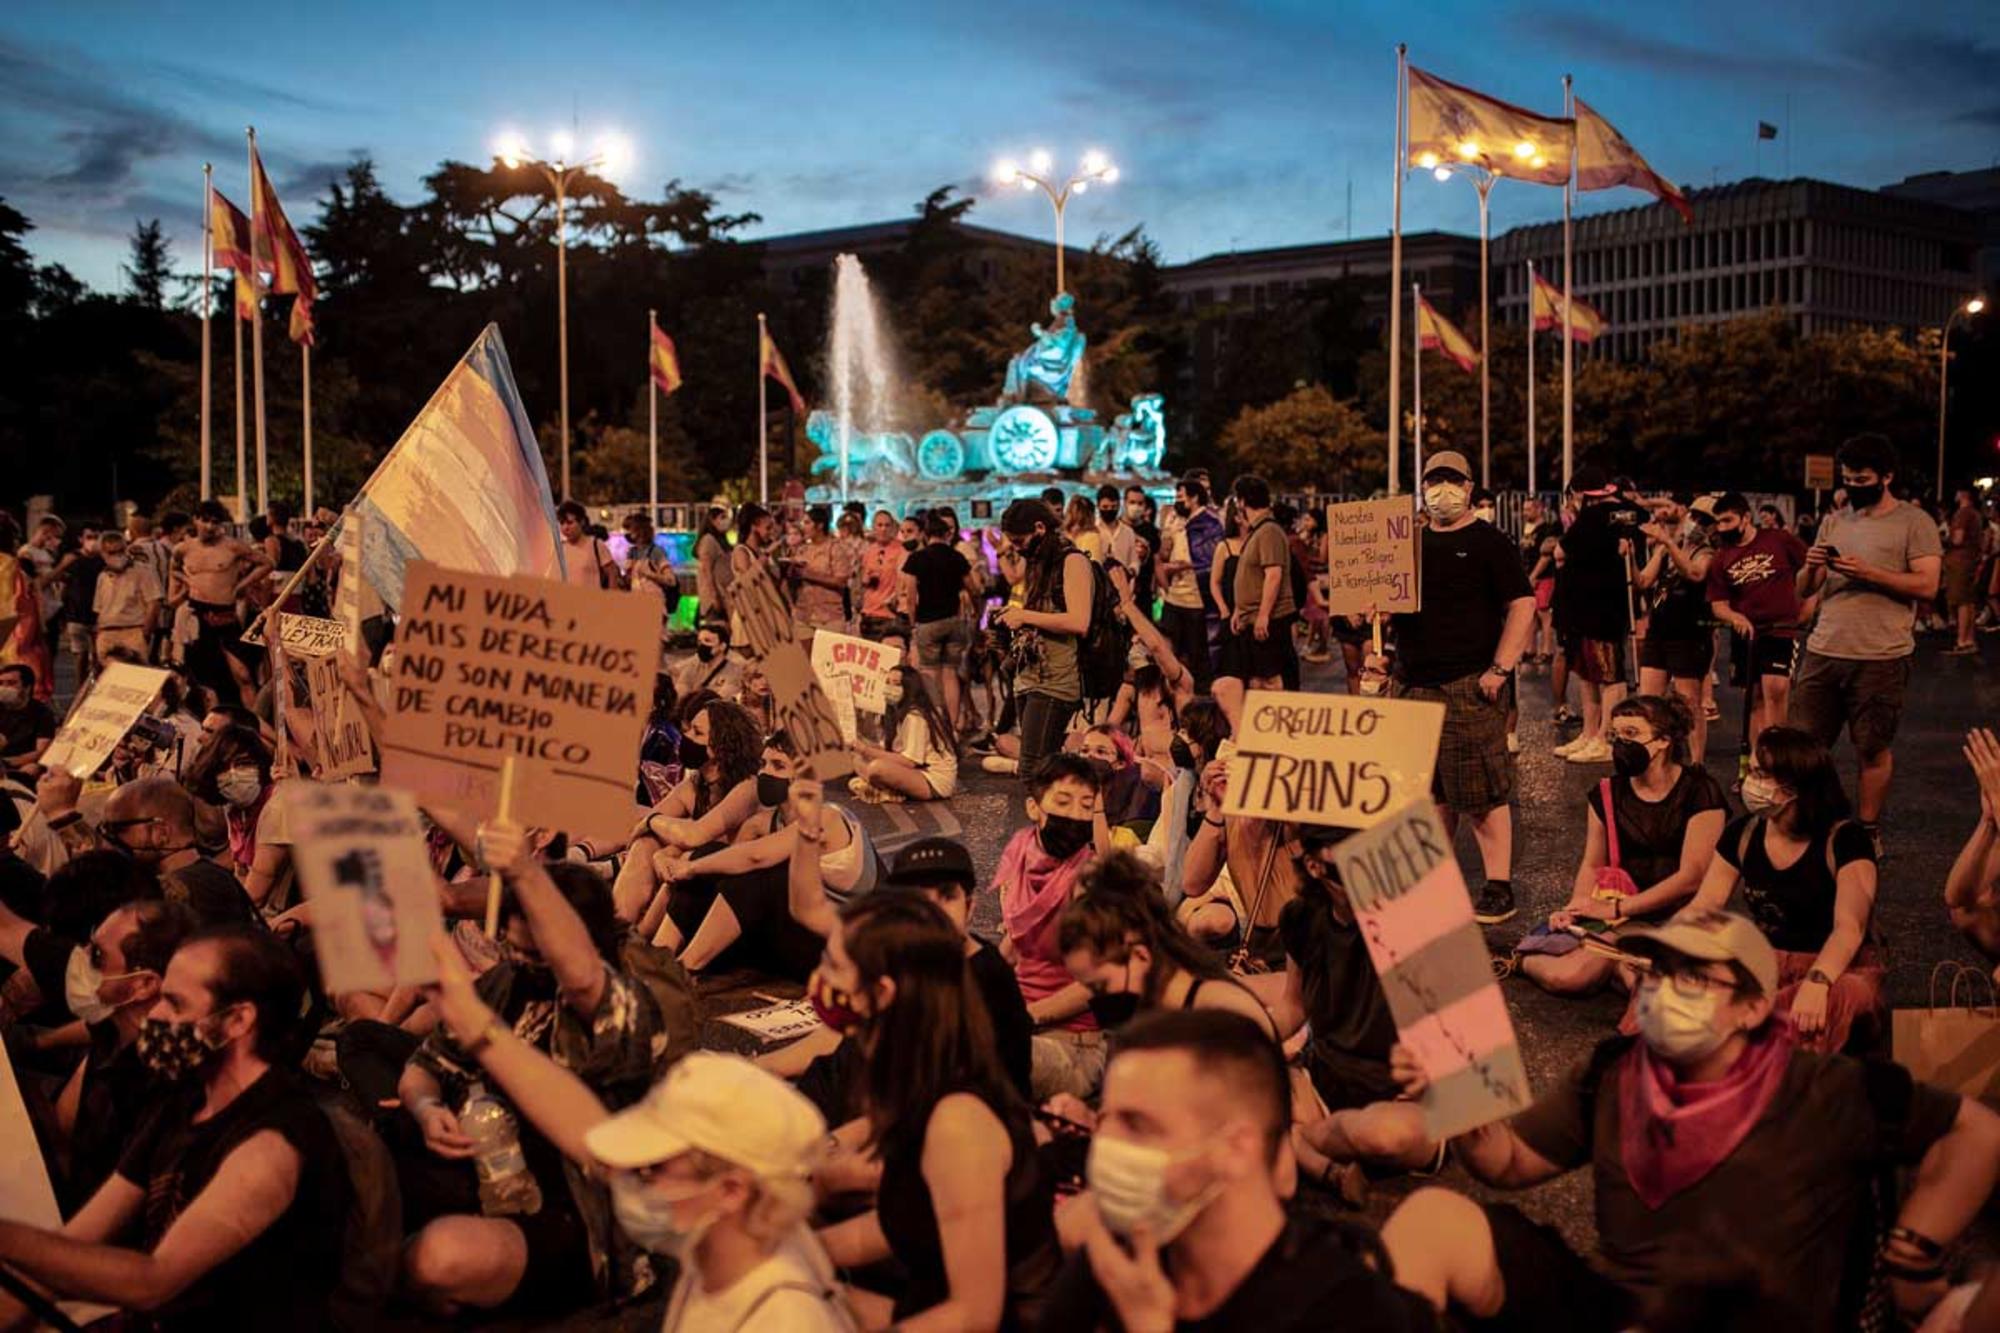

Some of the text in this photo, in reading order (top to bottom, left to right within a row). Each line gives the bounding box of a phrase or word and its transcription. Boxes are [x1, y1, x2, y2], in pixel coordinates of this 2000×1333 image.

[1335, 506, 1374, 525] Nuestra
[1386, 515, 1409, 540] NO
[1335, 528, 1378, 545] Identidad
[1348, 558, 1359, 566] un
[422, 584, 466, 612] MI
[403, 618, 468, 649] MIS
[400, 653, 638, 718] NO SON MONEDA
[396, 686, 554, 731] DE CAMBIO
[1252, 704, 1385, 739] ORGULLO
[1236, 750, 1391, 815] TRANS
[1349, 818, 1445, 911] QUEER
